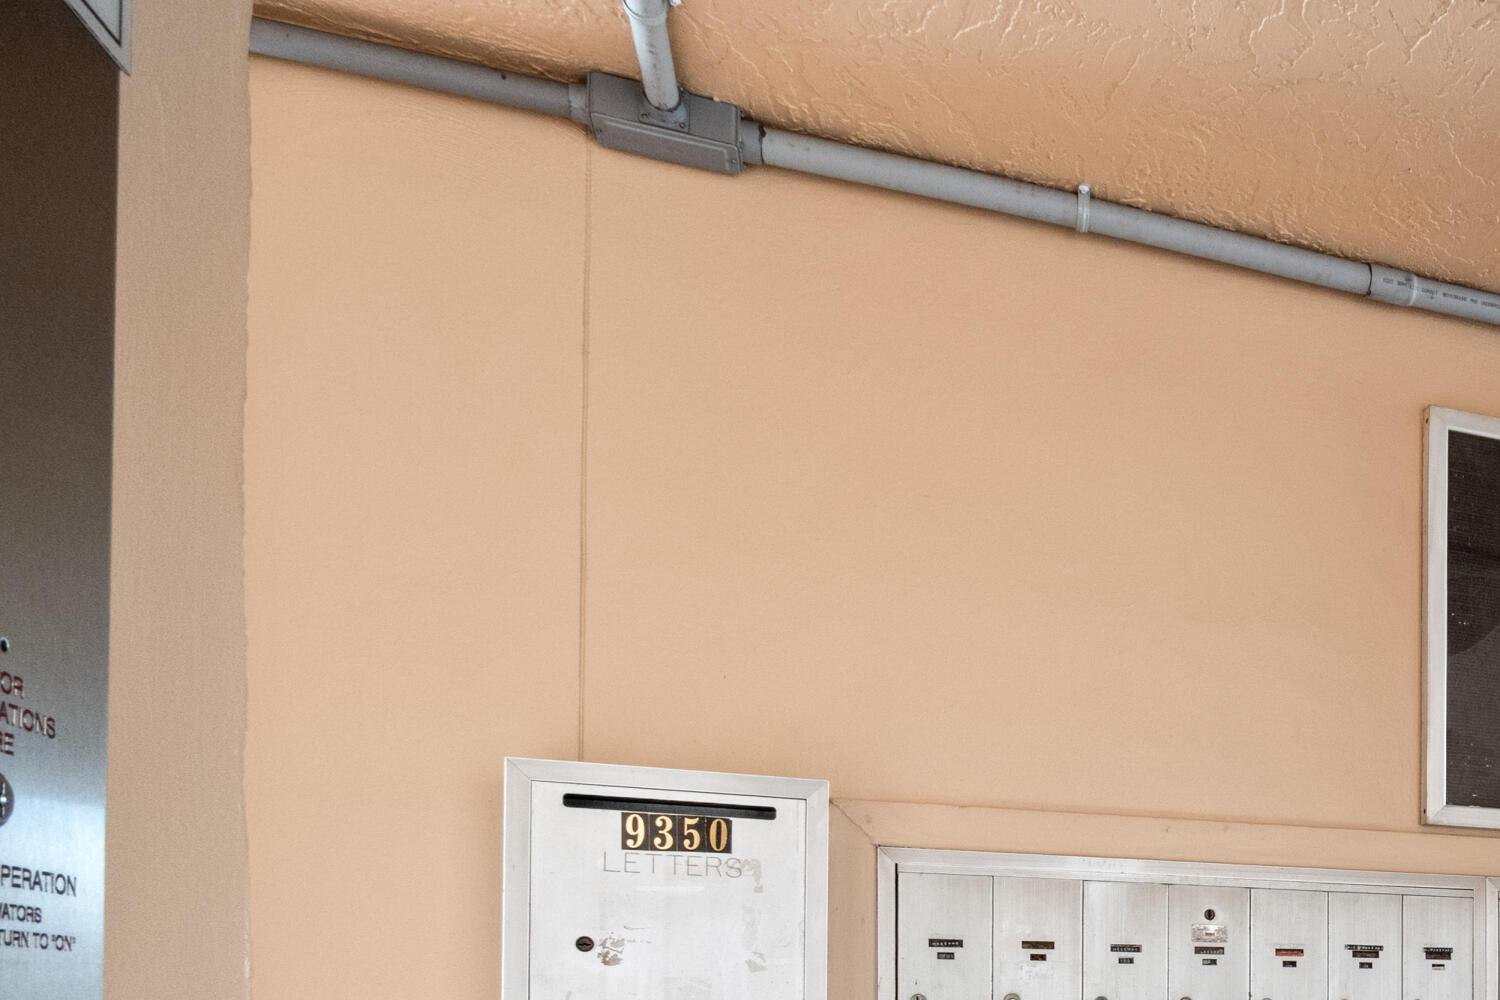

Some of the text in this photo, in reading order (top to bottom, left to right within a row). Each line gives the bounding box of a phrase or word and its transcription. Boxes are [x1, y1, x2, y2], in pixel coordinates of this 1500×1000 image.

[625, 813, 728, 851] 9350
[603, 851, 742, 878] LETTERS
[33, 932, 48, 949] TO
